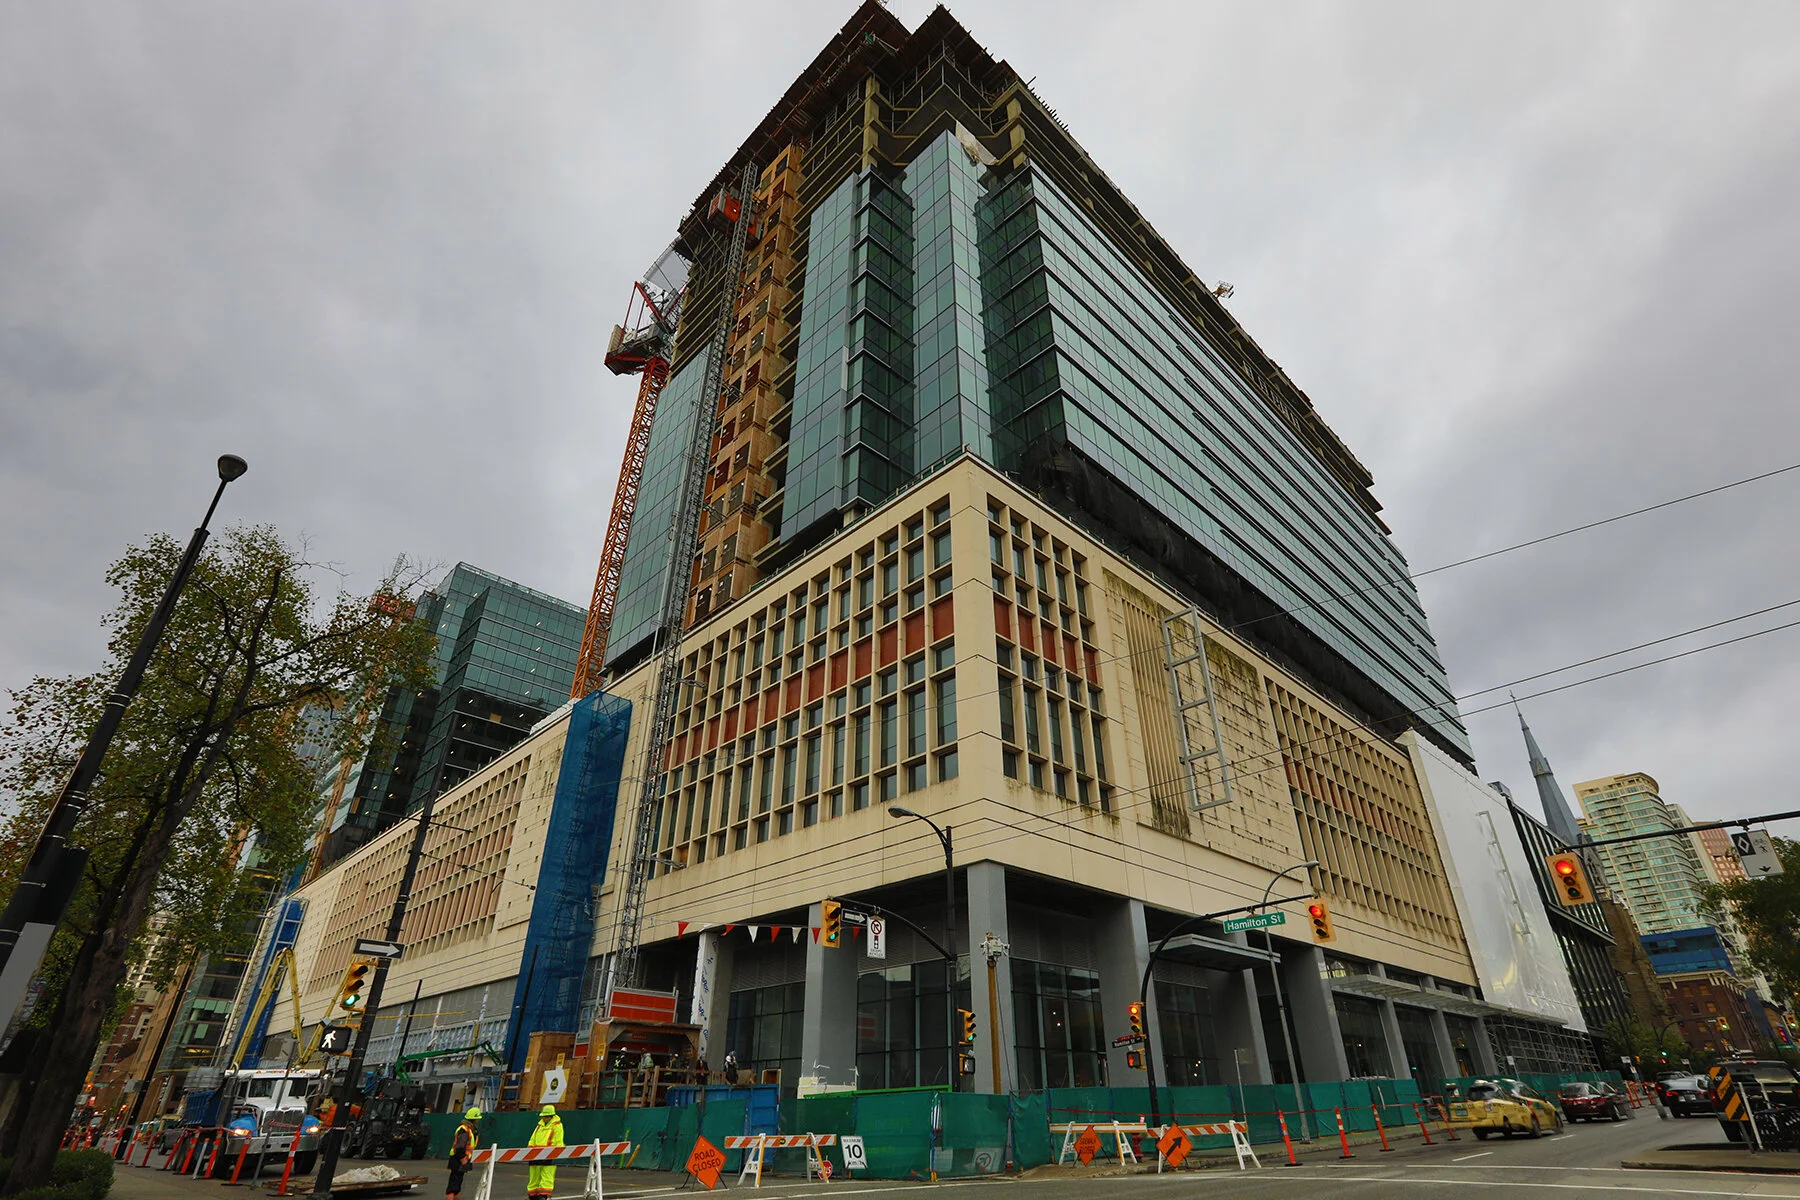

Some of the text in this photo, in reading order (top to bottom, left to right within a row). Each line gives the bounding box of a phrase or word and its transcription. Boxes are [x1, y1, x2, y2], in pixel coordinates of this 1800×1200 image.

[1227, 915, 1281, 931] Hamilton St
[694, 1149, 715, 1161] ROAD
[845, 1144, 862, 1158] 10
[692, 1157, 721, 1172] CLOSED
